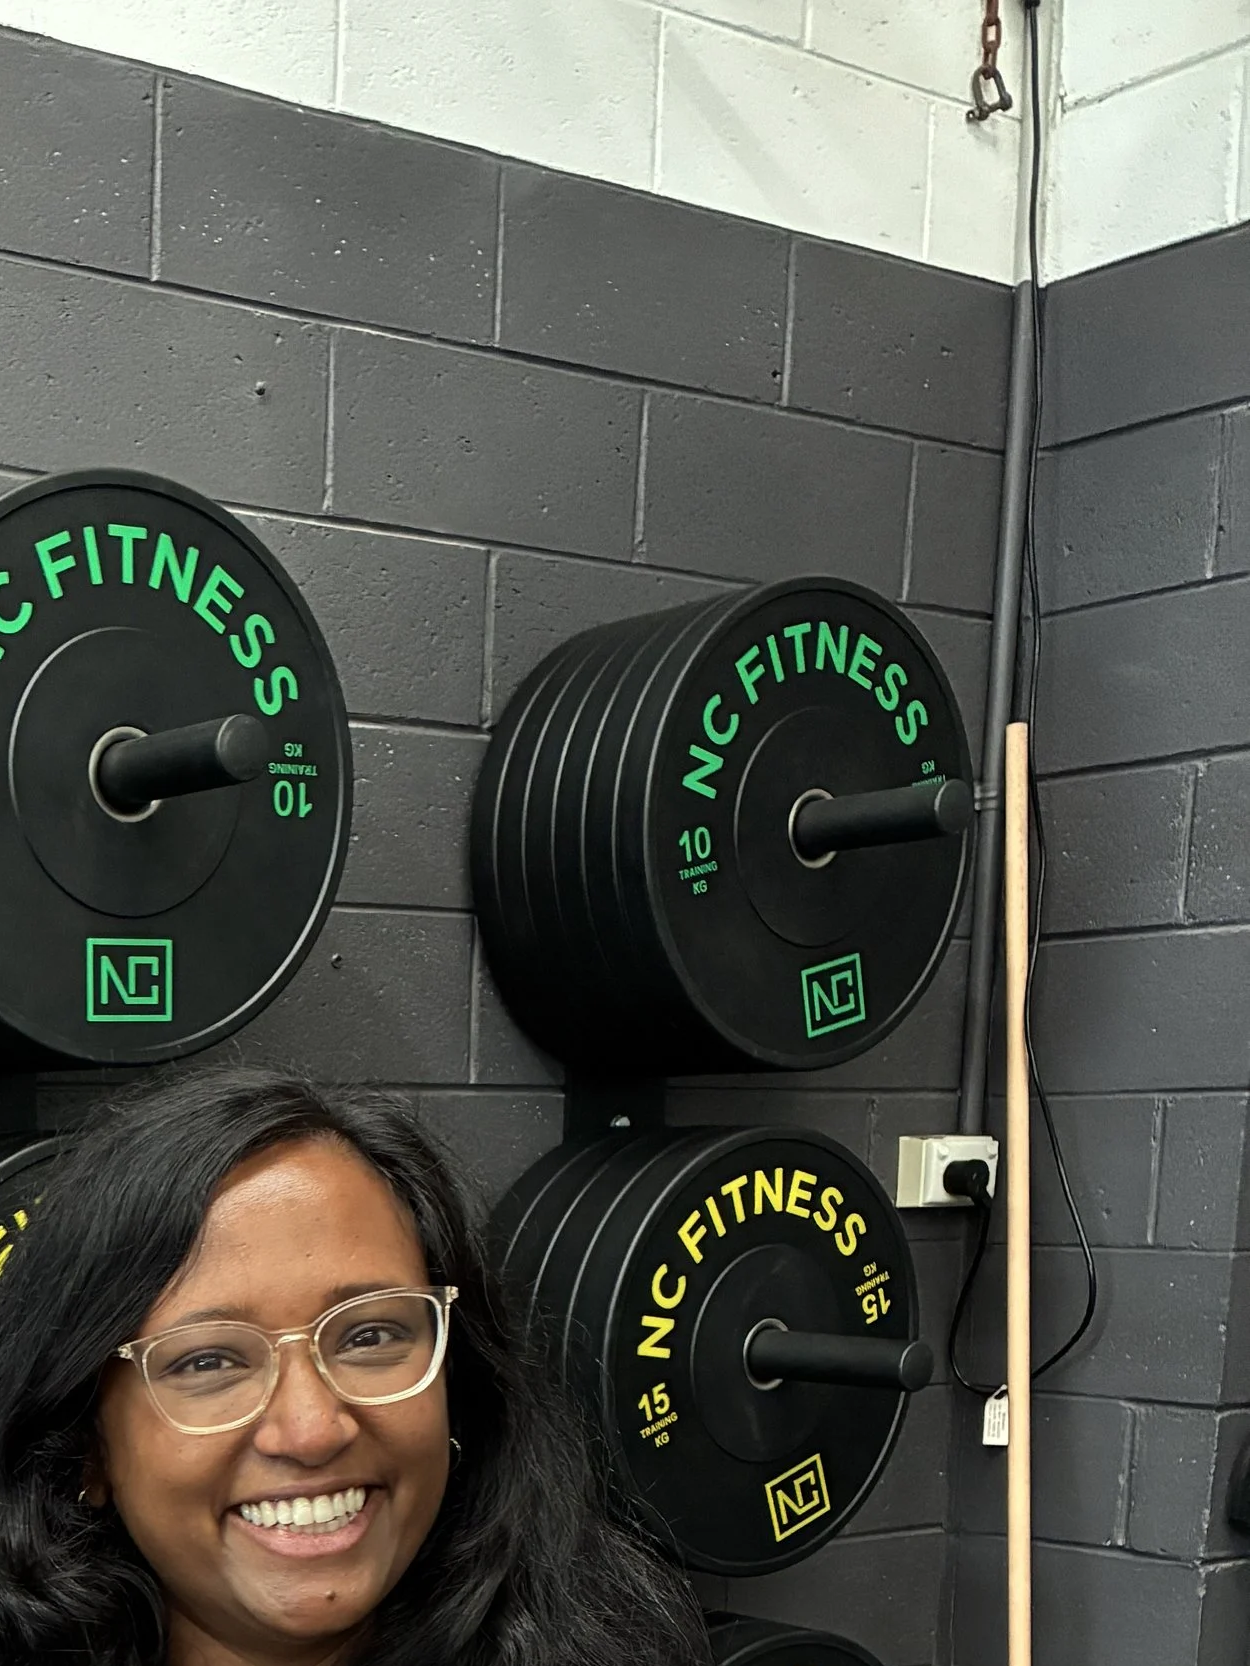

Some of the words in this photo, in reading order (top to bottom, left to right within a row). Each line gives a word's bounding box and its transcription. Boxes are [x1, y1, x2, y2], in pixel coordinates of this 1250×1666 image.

[35, 524, 298, 715] FITNESS
[683, 694, 739, 799] NC
[735, 621, 928, 745] FITNESS
[285, 743, 302, 756] KG
[269, 763, 317, 776] TRAINING
[274, 781, 312, 817] 10
[679, 827, 710, 861] 10
[679, 861, 717, 880] TRAINING
[693, 880, 707, 894] KG
[638, 1264, 686, 1358] NC
[678, 1168, 866, 1263] FITNESS
[862, 1288, 890, 1324] 15
[639, 1383, 669, 1421] 15
[640, 1412, 677, 1438] TRAINING
[655, 1432, 669, 1447] KG
